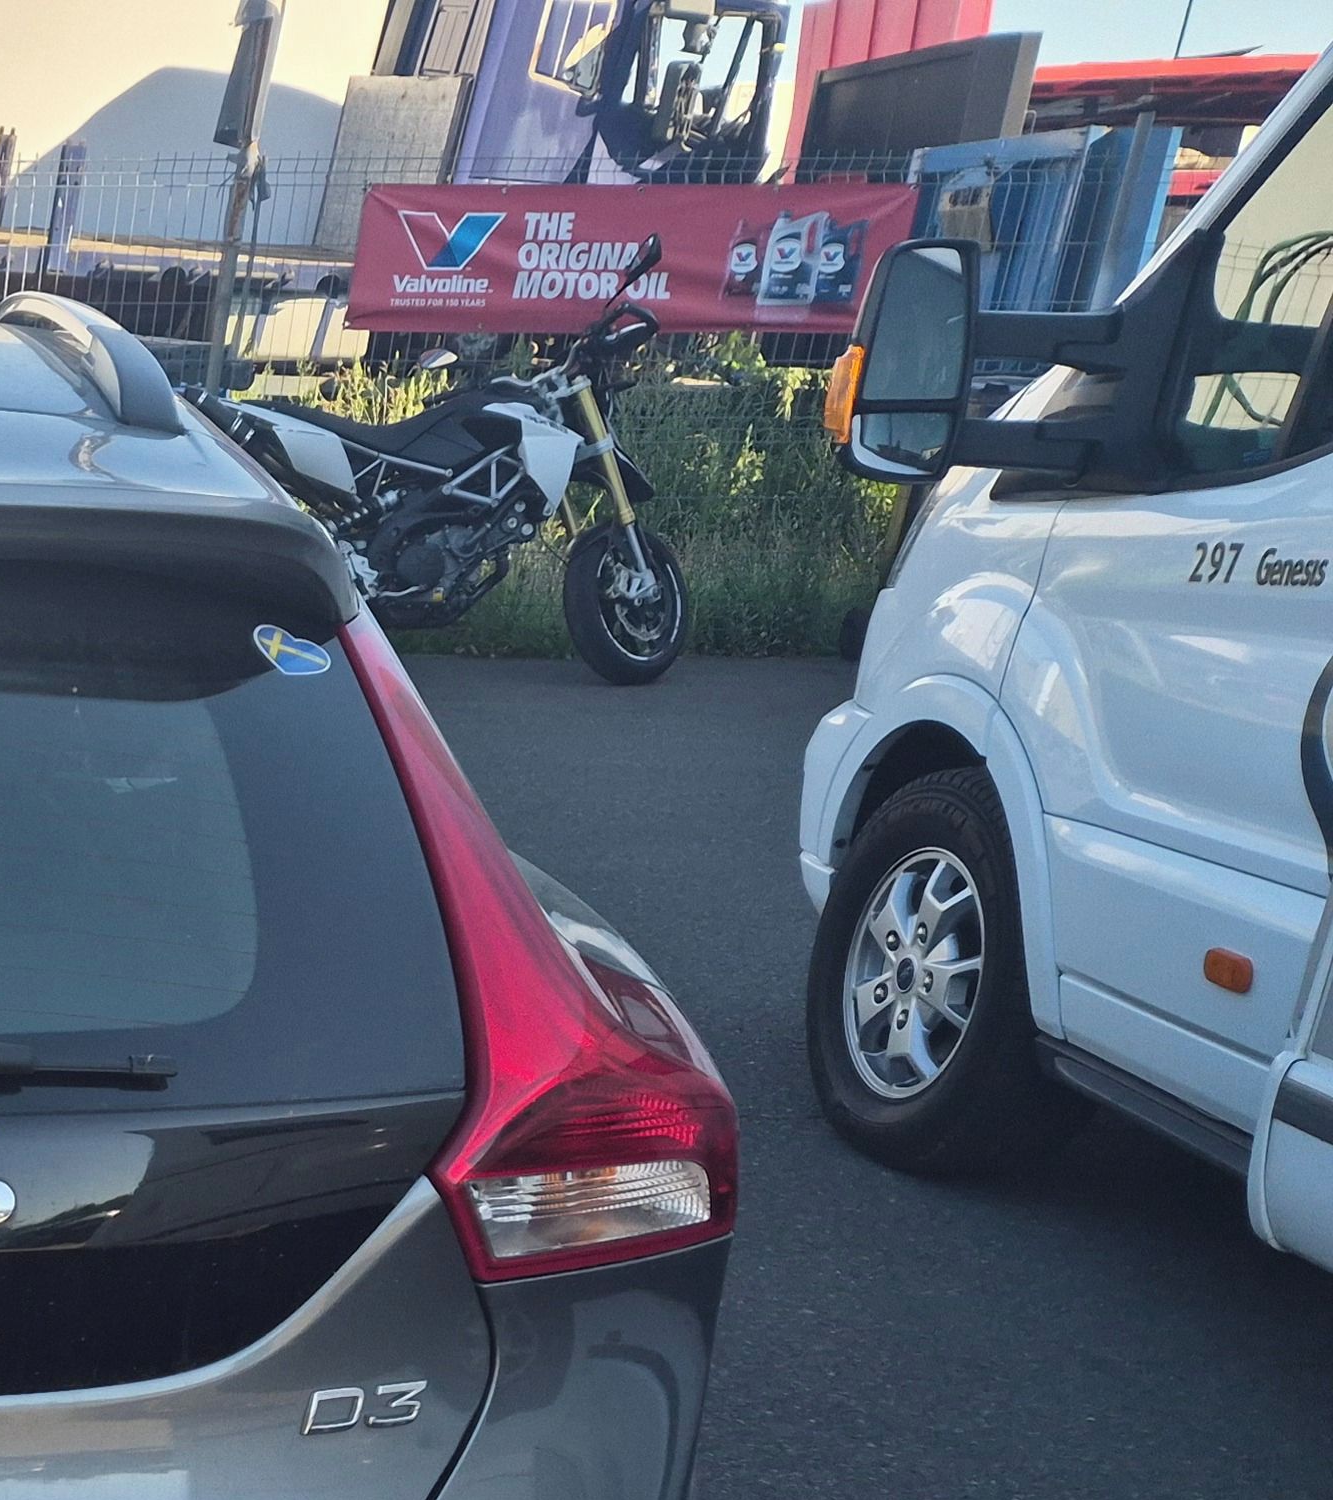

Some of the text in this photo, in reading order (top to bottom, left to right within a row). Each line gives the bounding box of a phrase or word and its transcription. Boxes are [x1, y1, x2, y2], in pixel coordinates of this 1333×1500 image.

[524, 212, 575, 241] THE
[518, 242, 641, 271] ORIGINA
[393, 275, 489, 293] Valvoline
[512, 271, 671, 299] MOTOR OIL
[390, 298, 426, 307] TRUSTED
[427, 298, 443, 307] FOR
[460, 298, 486, 308] YEARS
[1188, 541, 1329, 587] 297 Genesis
[300, 1379, 428, 1436] D3
